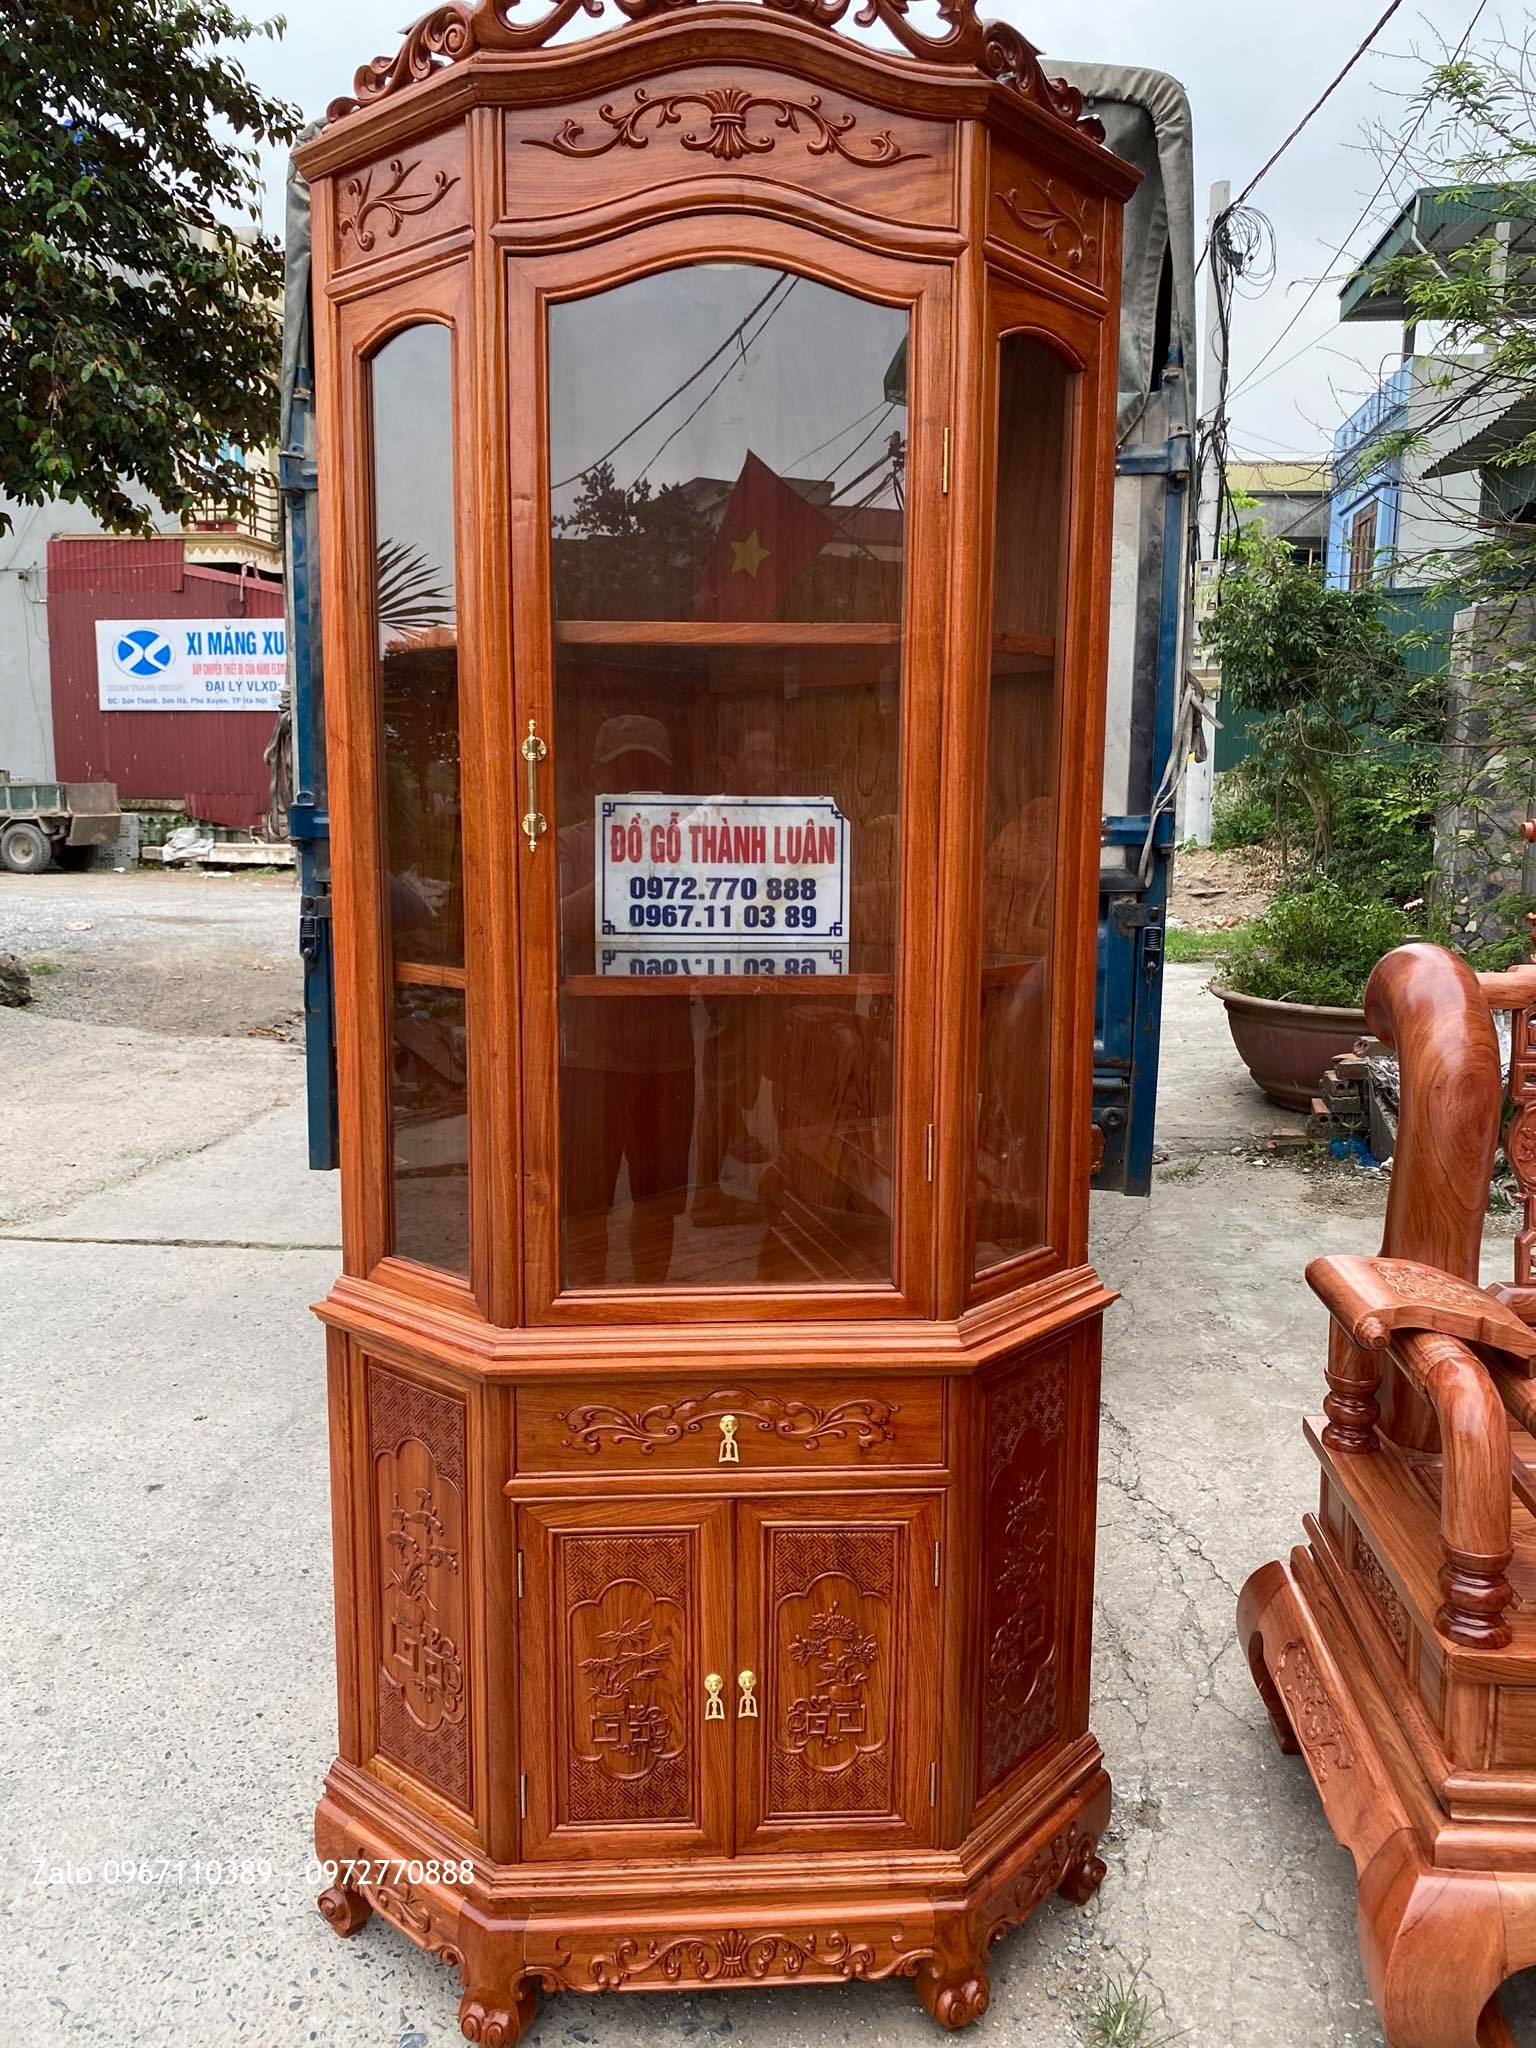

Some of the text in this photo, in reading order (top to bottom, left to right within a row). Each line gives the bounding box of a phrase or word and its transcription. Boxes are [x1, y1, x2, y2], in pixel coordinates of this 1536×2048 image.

[186, 625, 286, 655] XI MĂNG XU
[205, 680, 225, 693] ĐẠI
[229, 678, 243, 692] LÝ
[610, 811, 836, 865] ĐỒ GỖ THÀNH LUÂN
[629, 876, 817, 900] 0972.770 888
[629, 904, 817, 928] 0967.11 03 89
